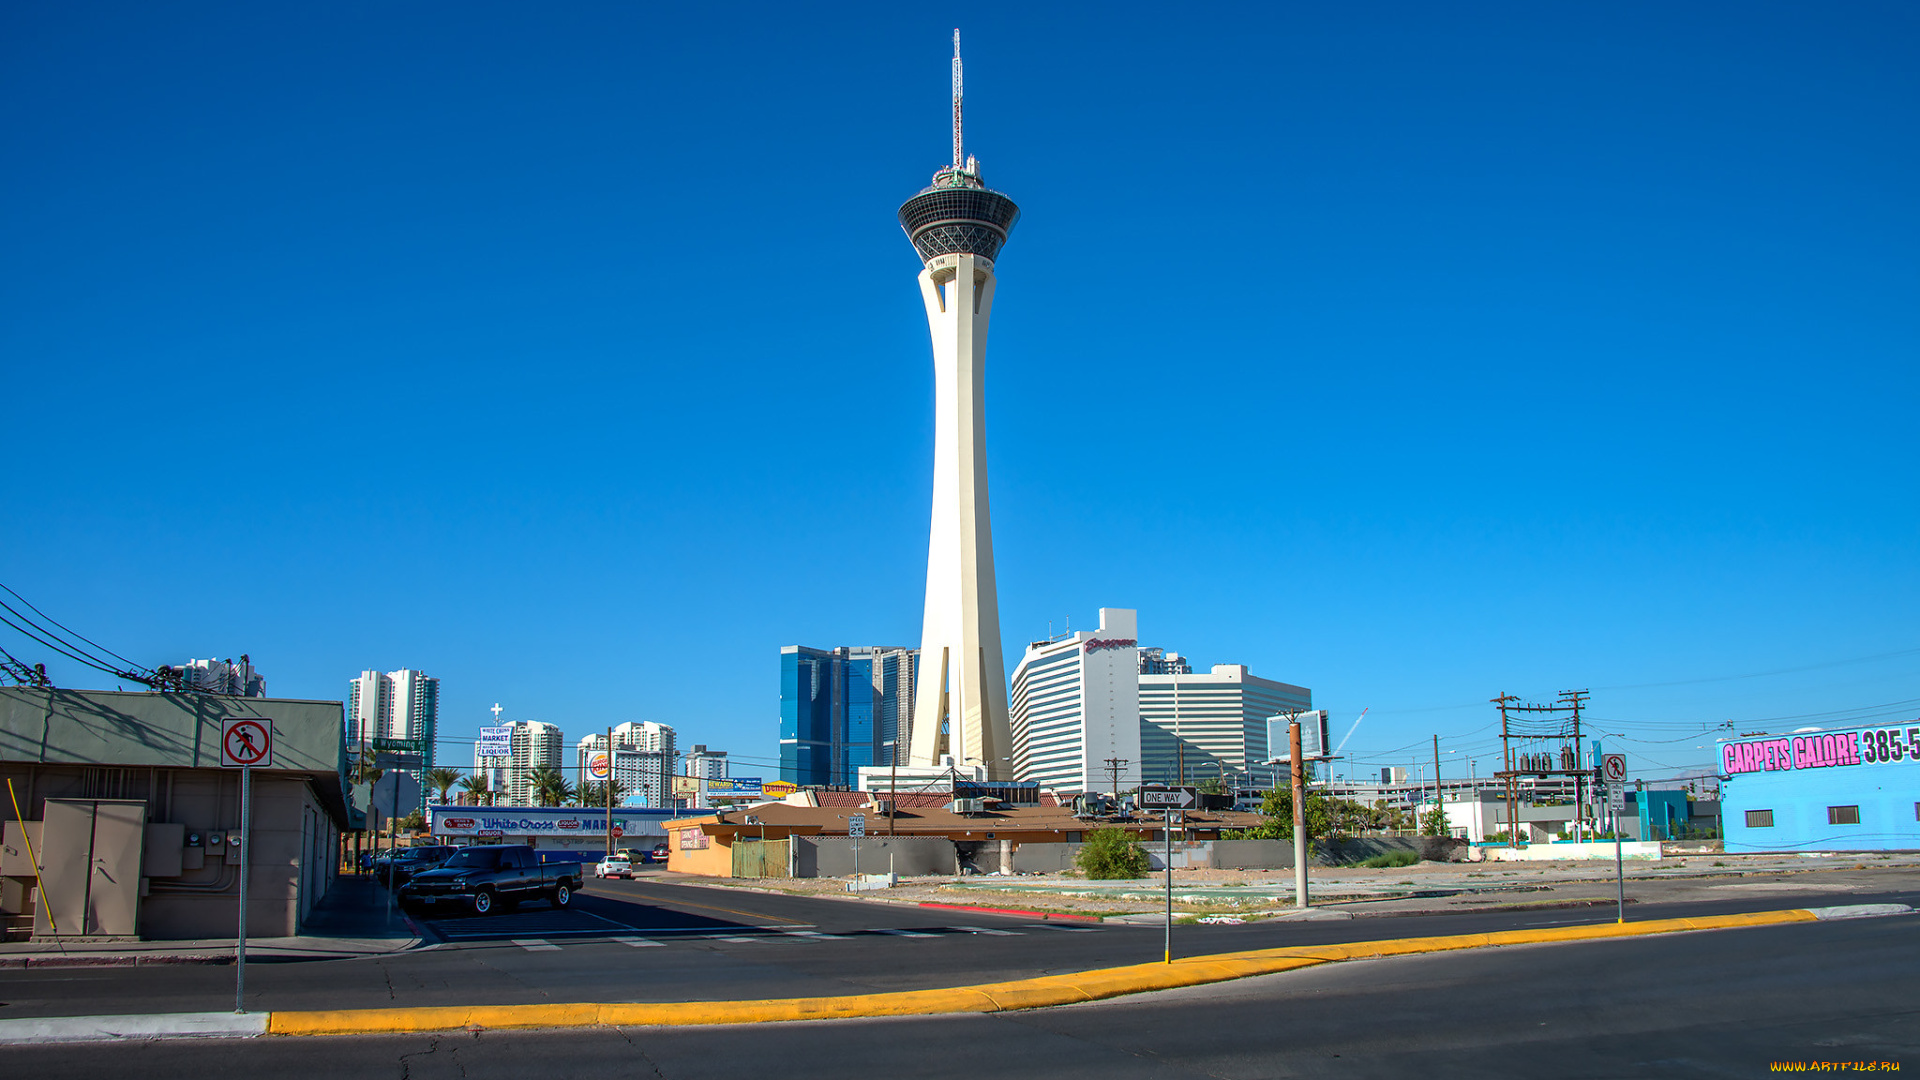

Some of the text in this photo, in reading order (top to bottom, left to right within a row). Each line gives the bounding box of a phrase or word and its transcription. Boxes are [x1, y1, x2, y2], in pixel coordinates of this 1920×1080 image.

[381, 740, 415, 750] Wyoming
[1723, 738, 1791, 774] CARPETS
[1792, 732, 1861, 769] GALORE
[765, 783, 796, 793] Denny's
[1145, 792, 1180, 802] ONE WAY
[480, 818, 554, 830] White Cross
[850, 827, 864, 836] 25
